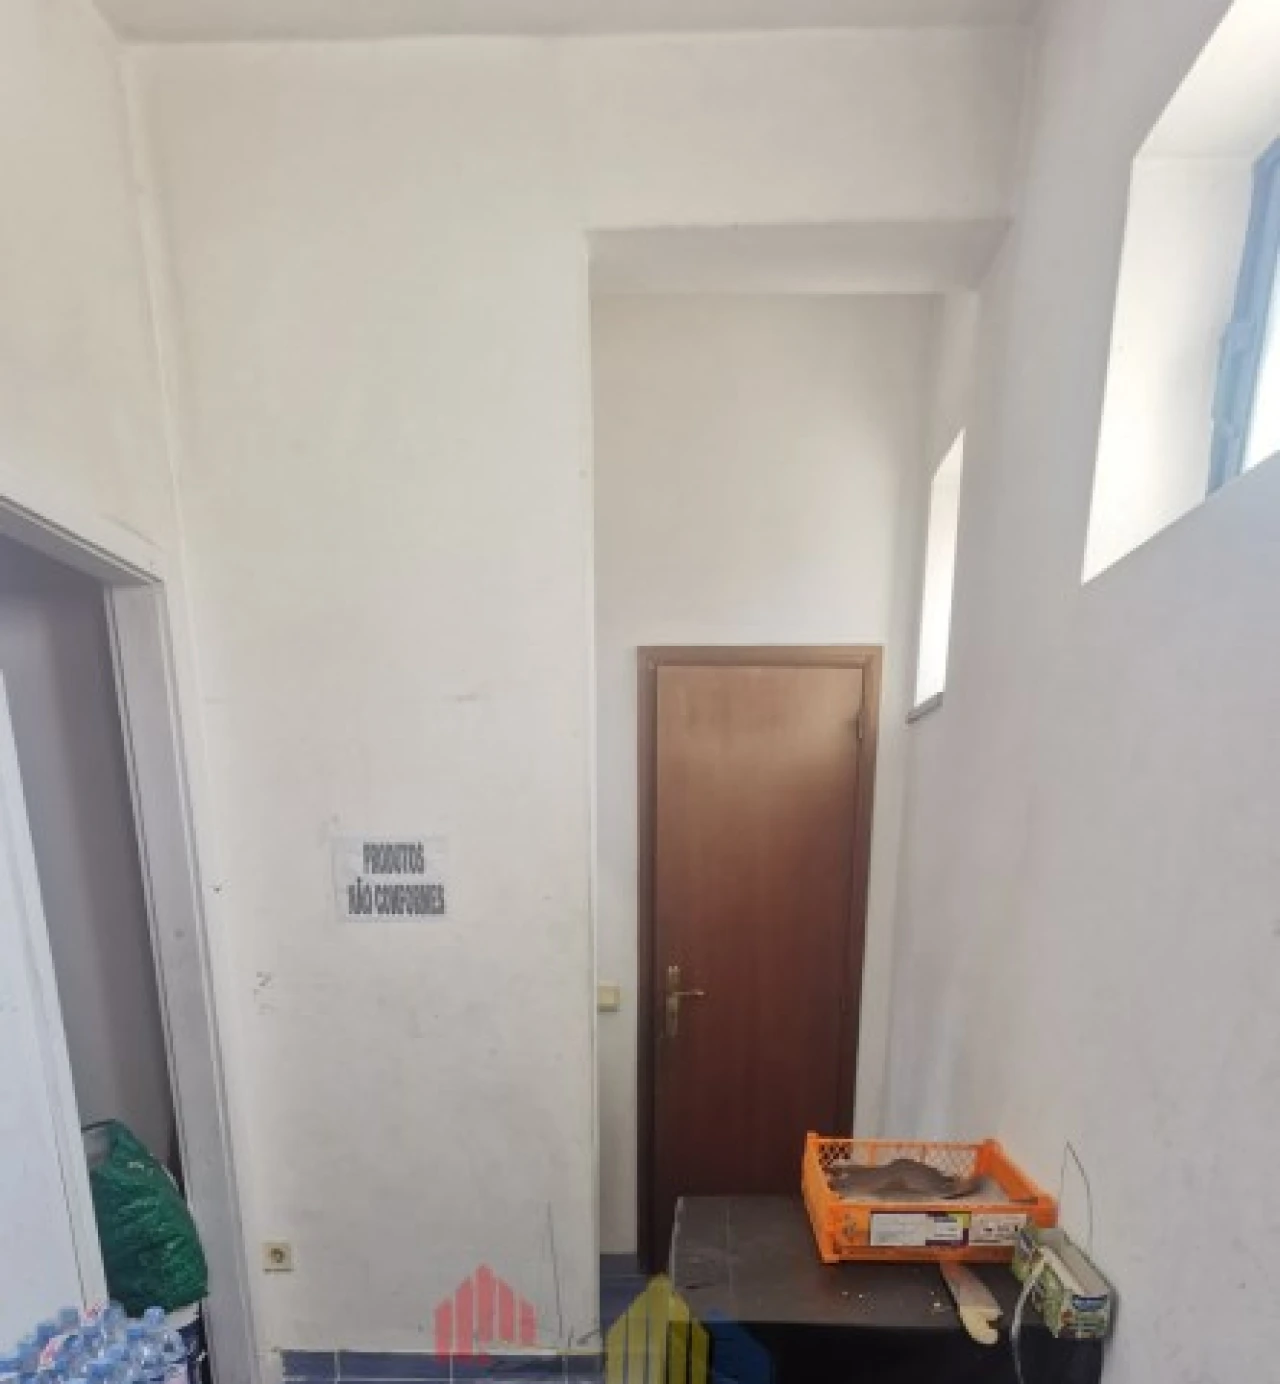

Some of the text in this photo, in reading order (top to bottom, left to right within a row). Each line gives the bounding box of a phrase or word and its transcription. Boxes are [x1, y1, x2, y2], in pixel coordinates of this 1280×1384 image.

[363, 842, 424, 874] PRODUTOS
[347, 876, 445, 915] NÃO CONFORMES
